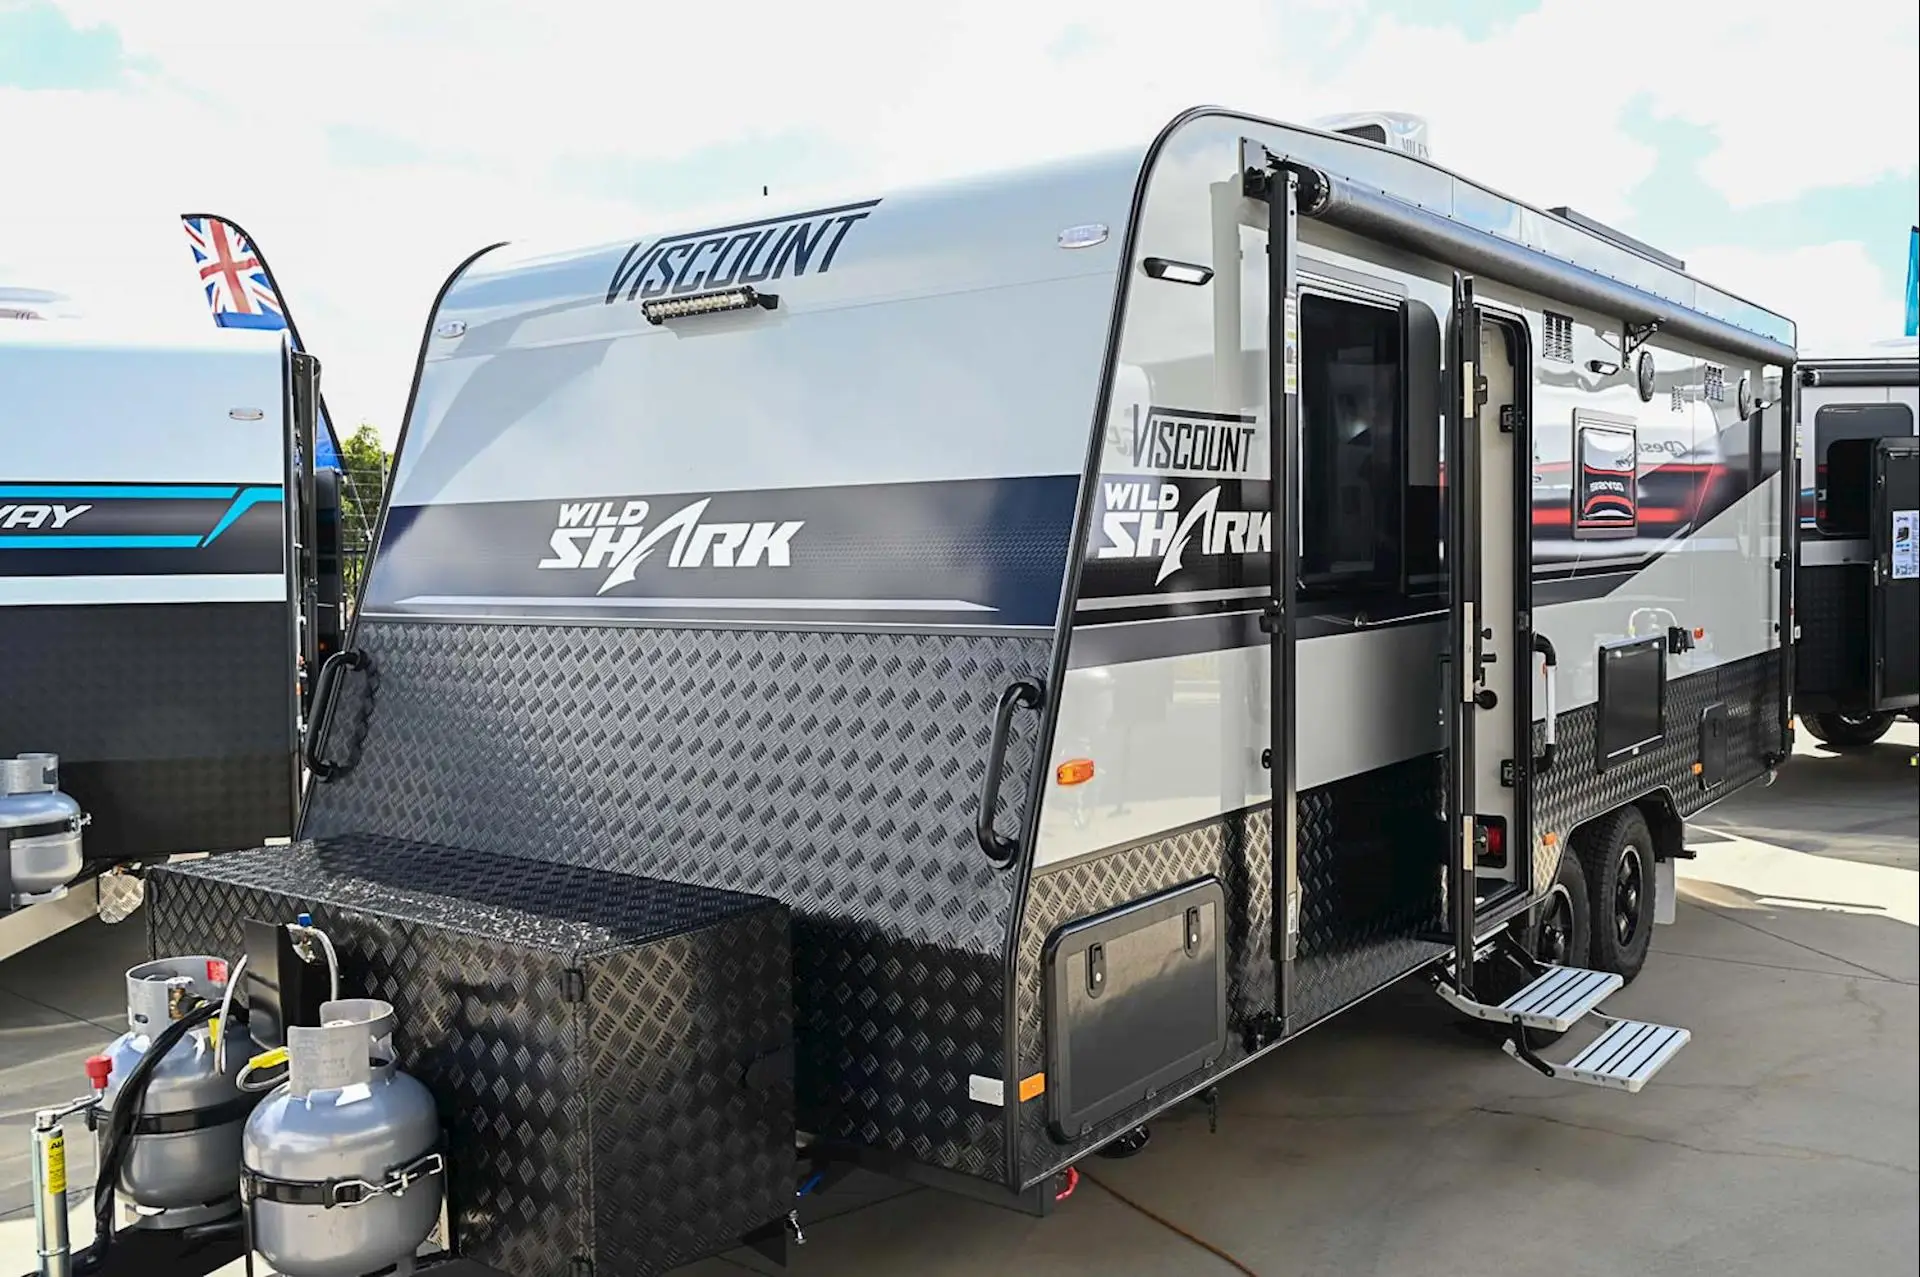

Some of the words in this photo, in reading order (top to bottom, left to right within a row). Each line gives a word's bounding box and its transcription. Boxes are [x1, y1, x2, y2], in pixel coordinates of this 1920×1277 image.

[605, 198, 883, 304] VISCOUNT
[1133, 404, 1256, 472] VISCOUNT
[558, 500, 650, 527] WILD
[1104, 482, 1179, 510] WILD
[538, 497, 805, 596] SHARK
